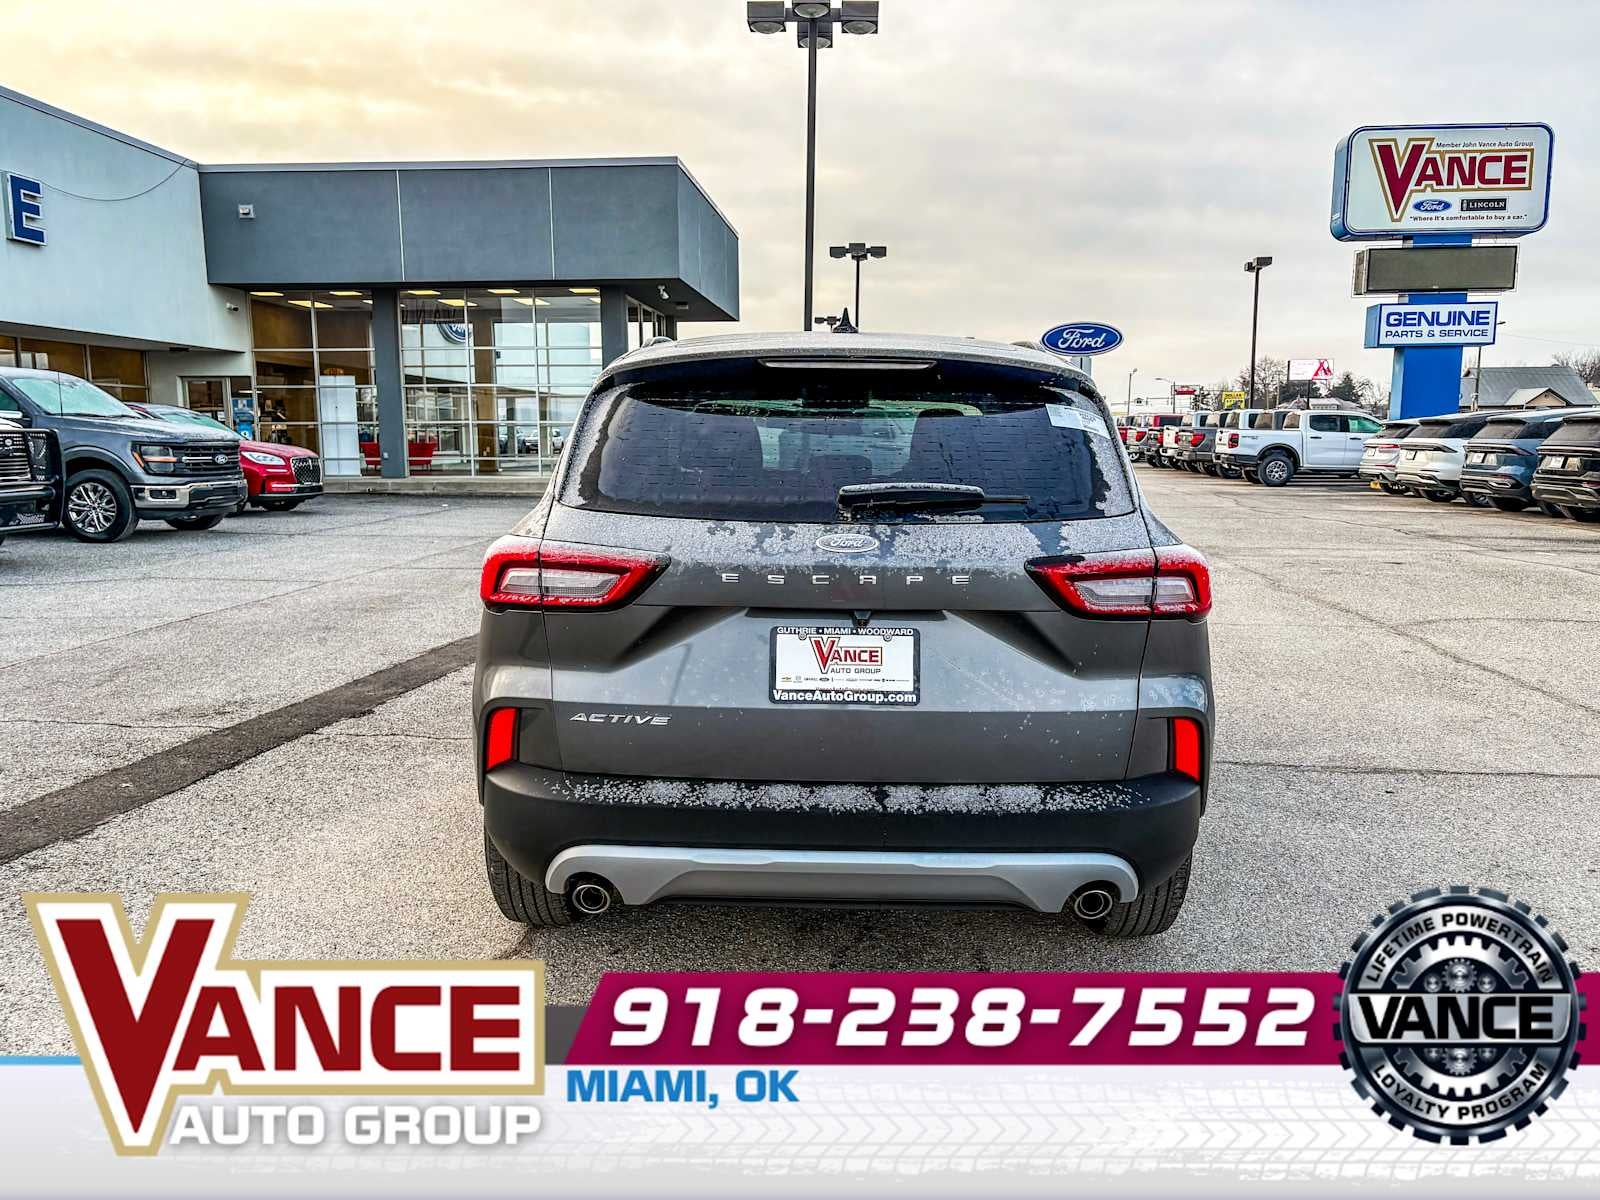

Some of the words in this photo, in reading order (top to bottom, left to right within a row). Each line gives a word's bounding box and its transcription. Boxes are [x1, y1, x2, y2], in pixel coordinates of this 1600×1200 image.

[1376, 143, 1528, 216] VANCE
[1420, 199, 1445, 211] Ford
[1469, 200, 1505, 209] LINCOLN
[1385, 310, 1491, 328] GENUINE
[1057, 328, 1107, 349] Ford
[1385, 329, 1423, 338] PARTS
[1427, 329, 1435, 338] &
[1439, 328, 1489, 338] SERVICE
[829, 536, 865, 548] Ford
[777, 627, 817, 635] GUTHRIE
[823, 627, 851, 635] MIAMI
[857, 627, 914, 636] WOODWARD
[813, 639, 879, 672] VANCE
[773, 689, 917, 704] VanceAutoGroup.com
[569, 712, 672, 726] ACTIVE
